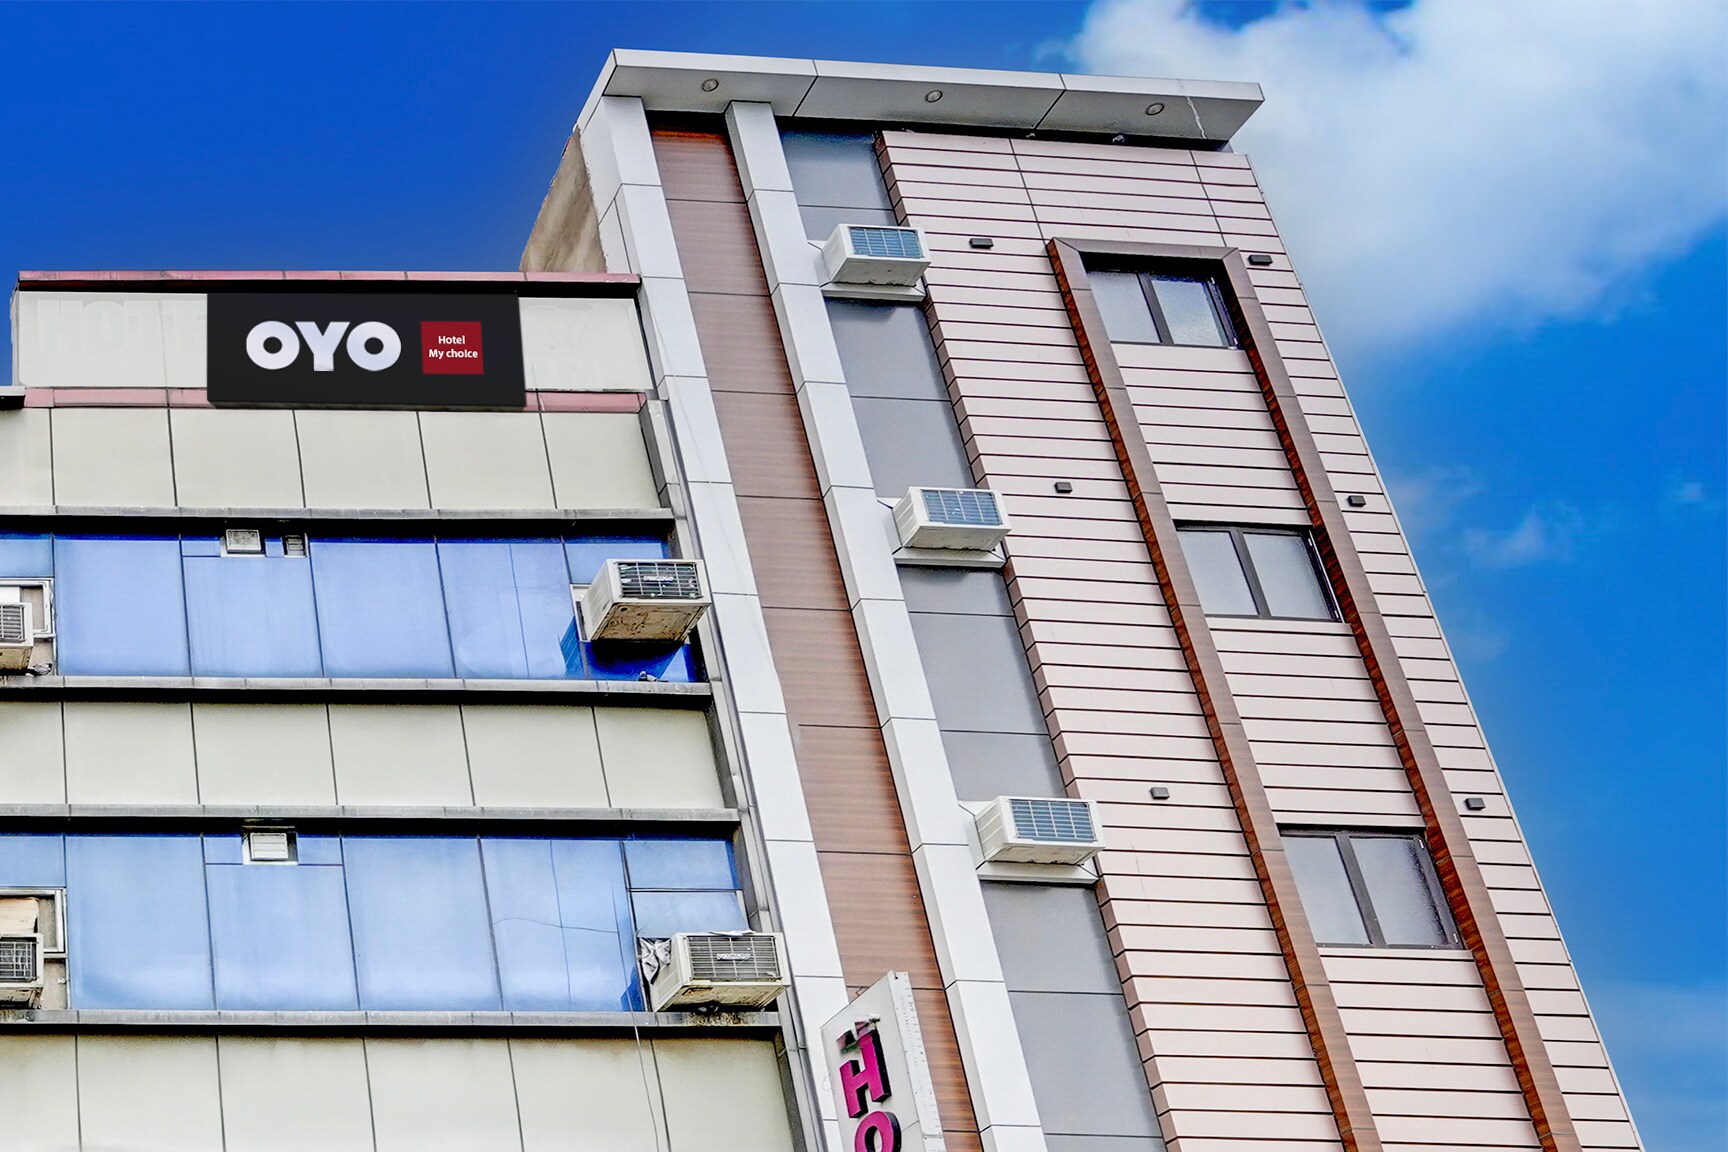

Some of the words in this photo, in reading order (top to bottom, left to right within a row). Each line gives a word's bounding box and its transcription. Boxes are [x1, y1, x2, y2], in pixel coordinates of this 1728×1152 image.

[246, 320, 402, 372] OYO
[438, 335, 466, 345] Hotel
[428, 348, 444, 360] My
[445, 348, 479, 358] choice
